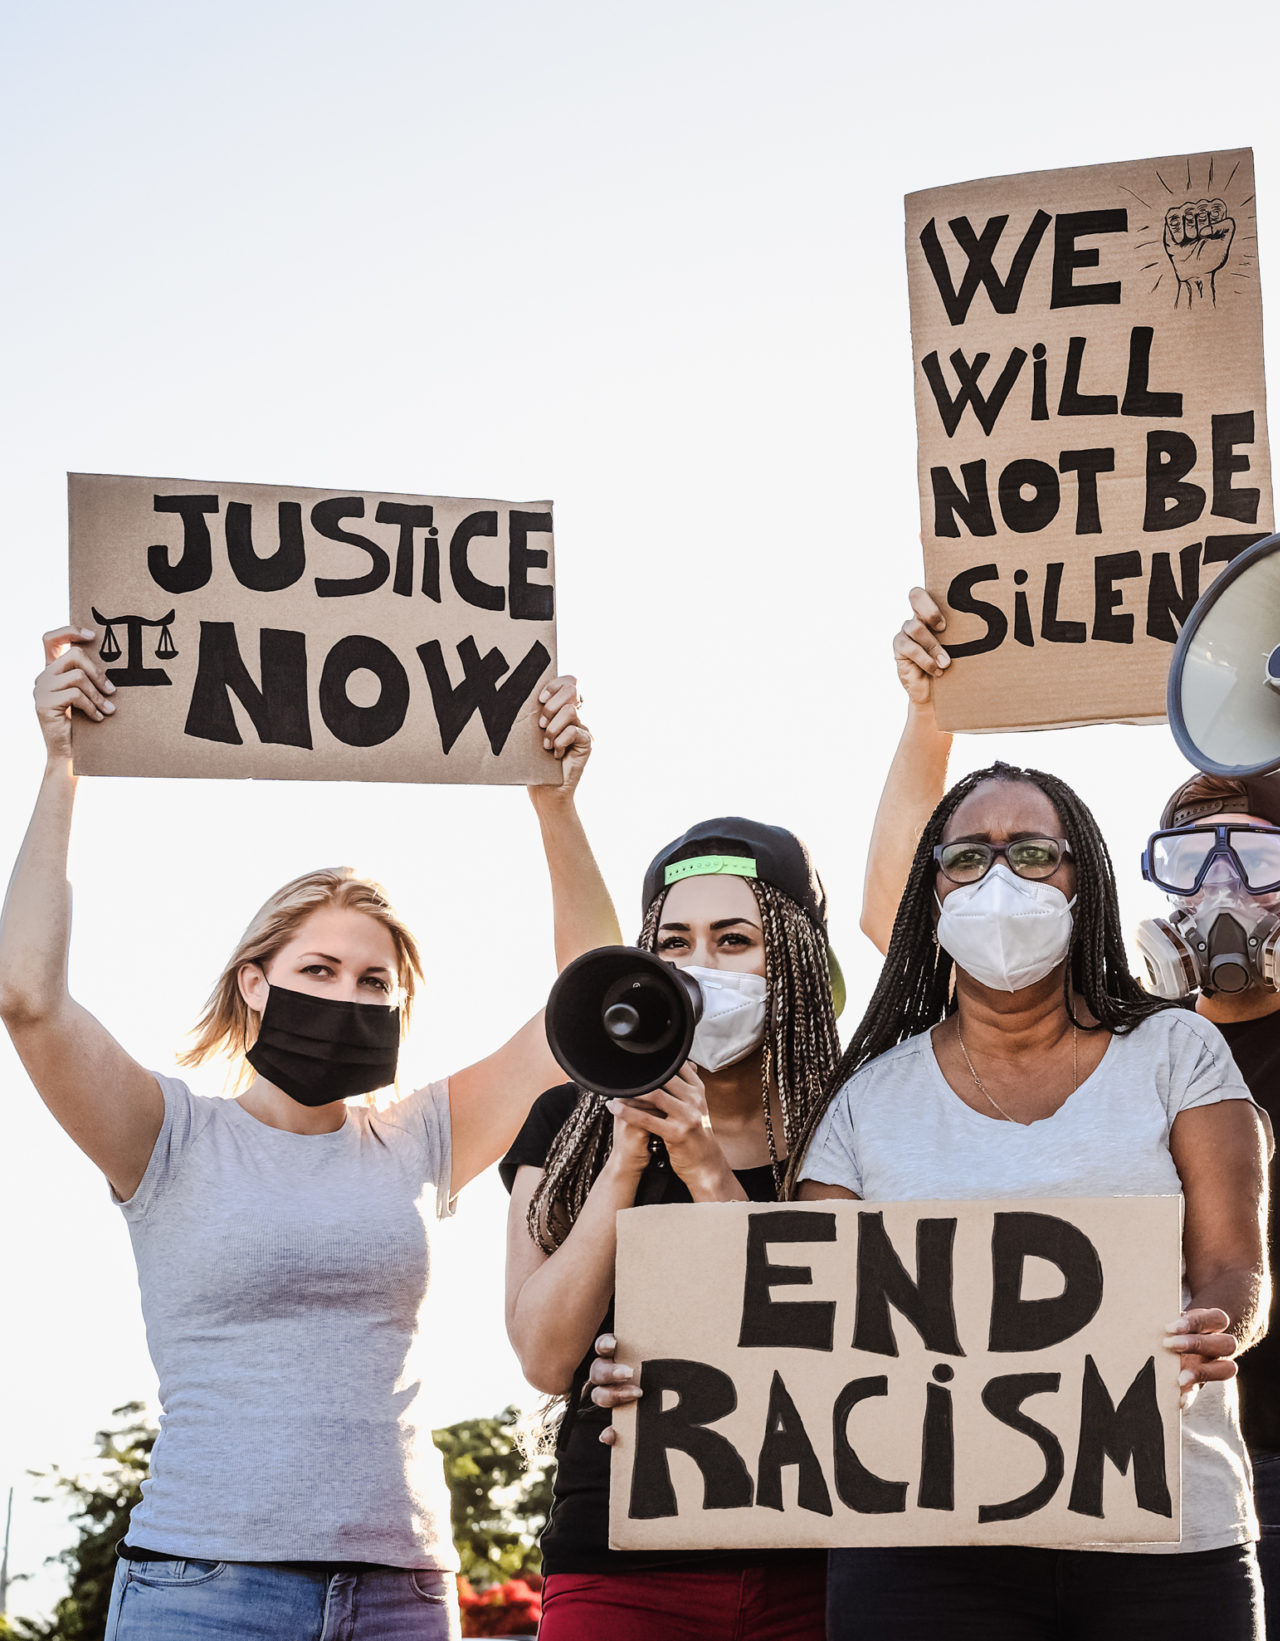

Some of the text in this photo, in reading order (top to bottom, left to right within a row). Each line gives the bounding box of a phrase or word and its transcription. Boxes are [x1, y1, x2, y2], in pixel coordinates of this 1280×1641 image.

[920, 208, 1128, 326] WE
[930, 410, 1261, 538] NOT BE
[183, 620, 552, 757] NOW
[737, 1210, 1104, 1357] END
